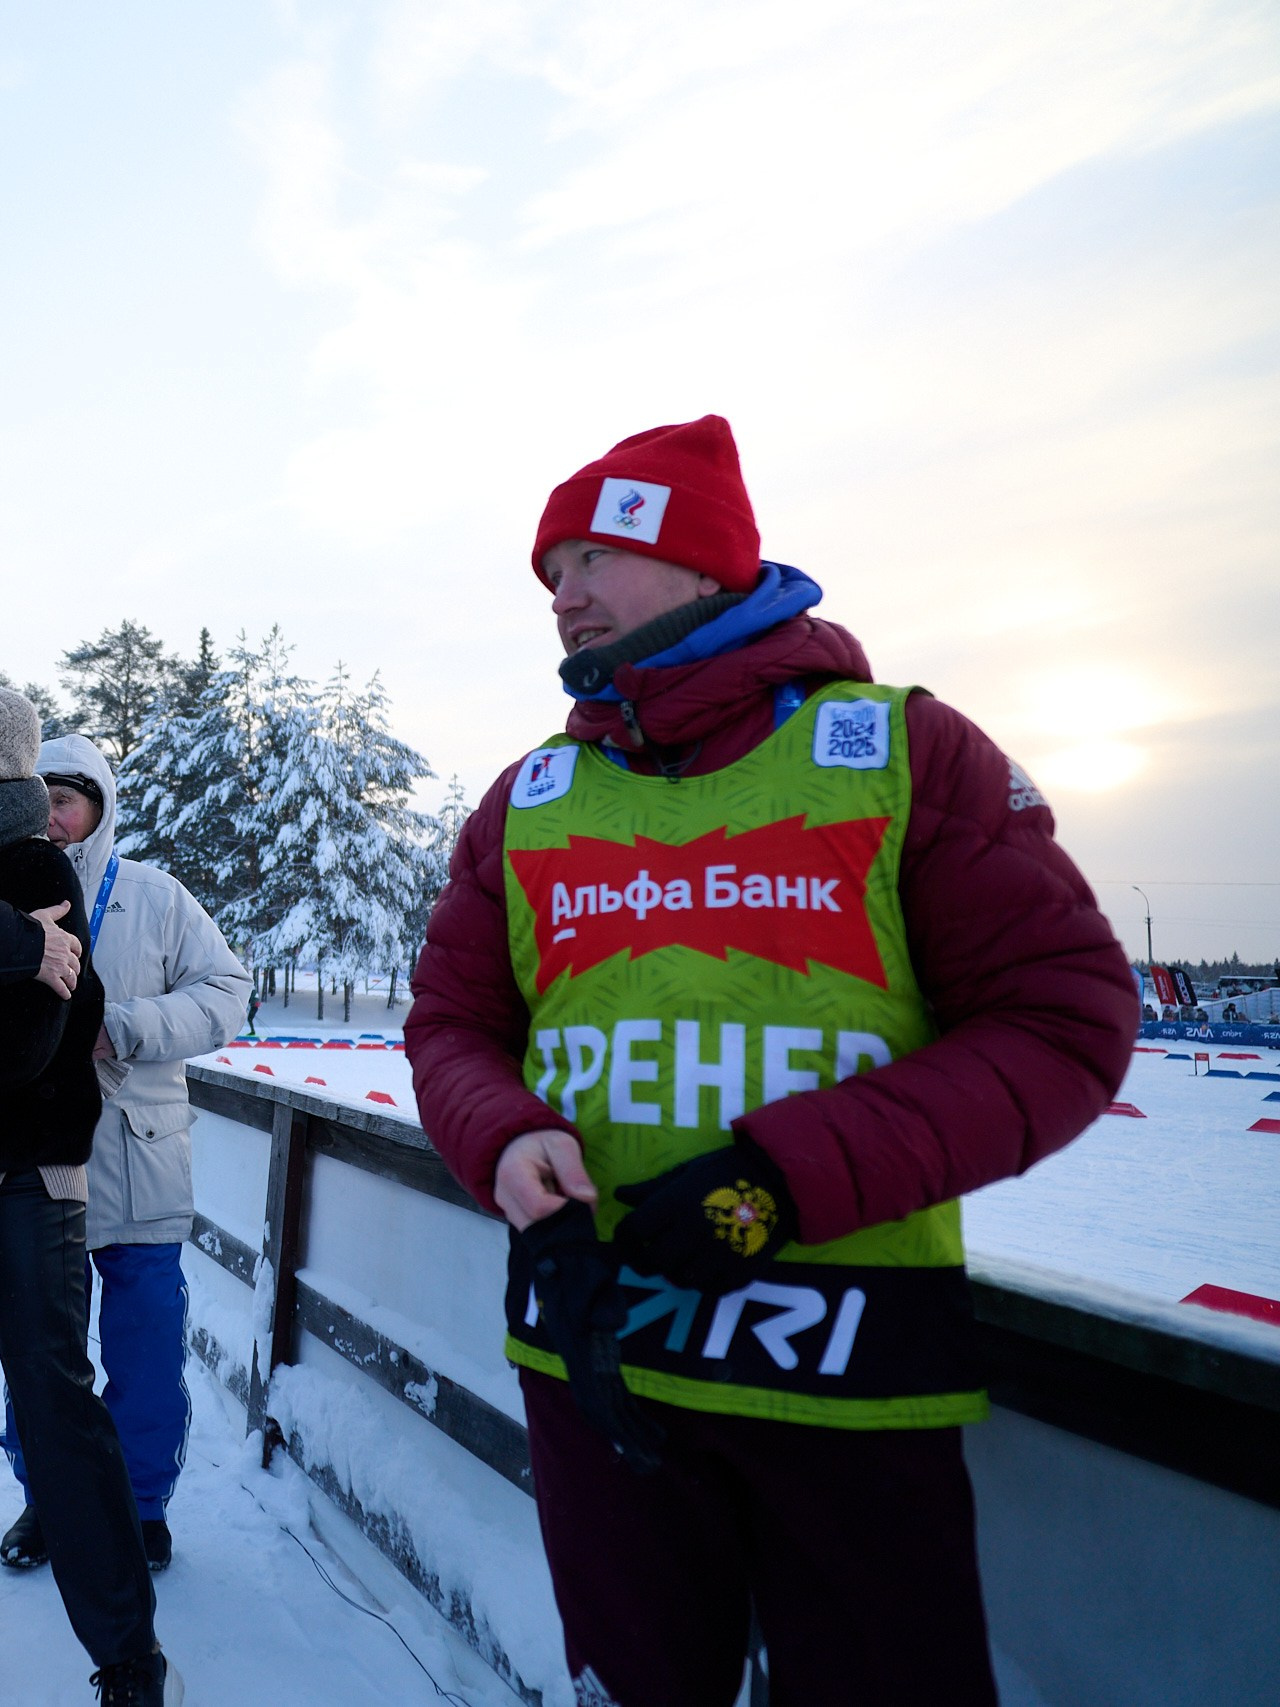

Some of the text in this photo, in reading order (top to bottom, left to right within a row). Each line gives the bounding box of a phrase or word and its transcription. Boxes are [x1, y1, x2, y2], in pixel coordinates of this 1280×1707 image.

[831, 719, 876, 739] 2024
[828, 738, 876, 759] 2025
[552, 864, 843, 930] Альфа Банк
